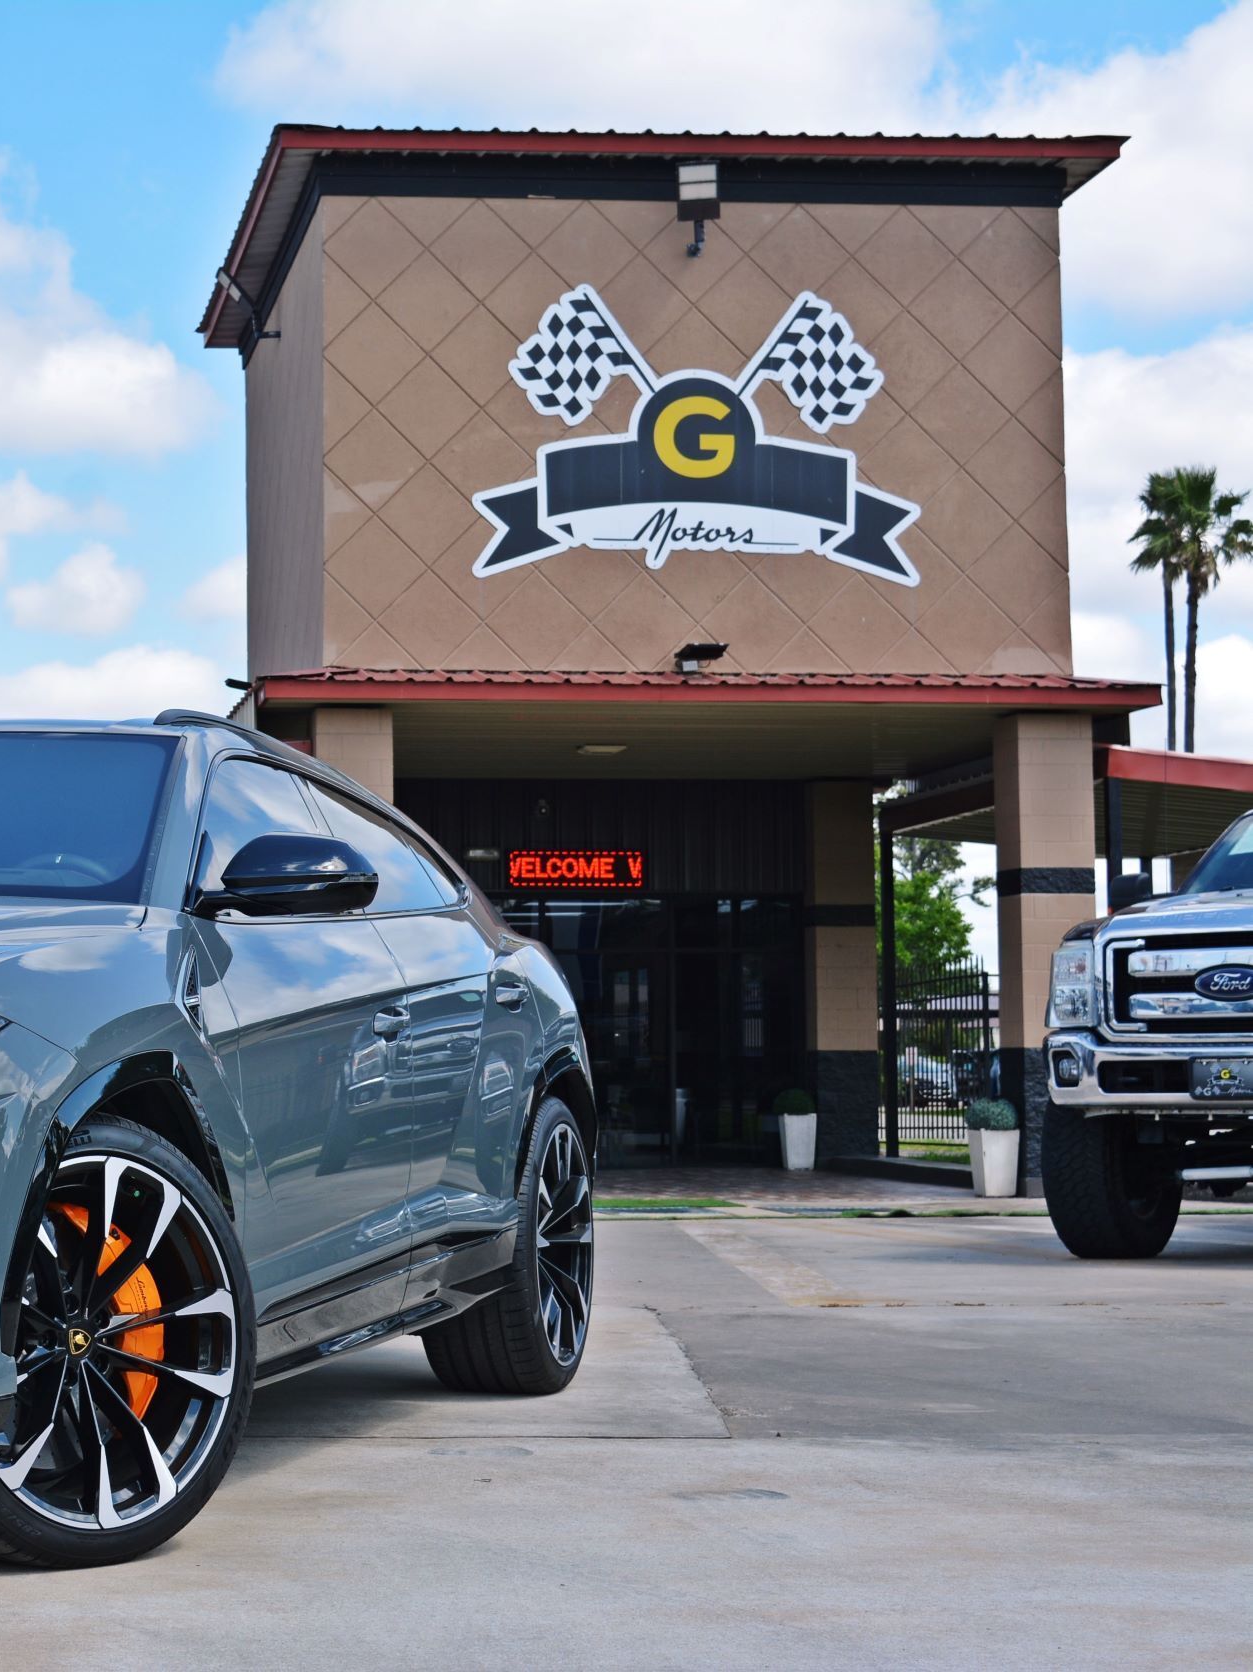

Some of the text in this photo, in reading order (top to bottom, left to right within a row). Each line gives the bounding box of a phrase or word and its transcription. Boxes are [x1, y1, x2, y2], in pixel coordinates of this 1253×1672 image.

[653, 395, 735, 478] G
[633, 507, 753, 560] Motors
[1210, 972, 1251, 990] Ford
